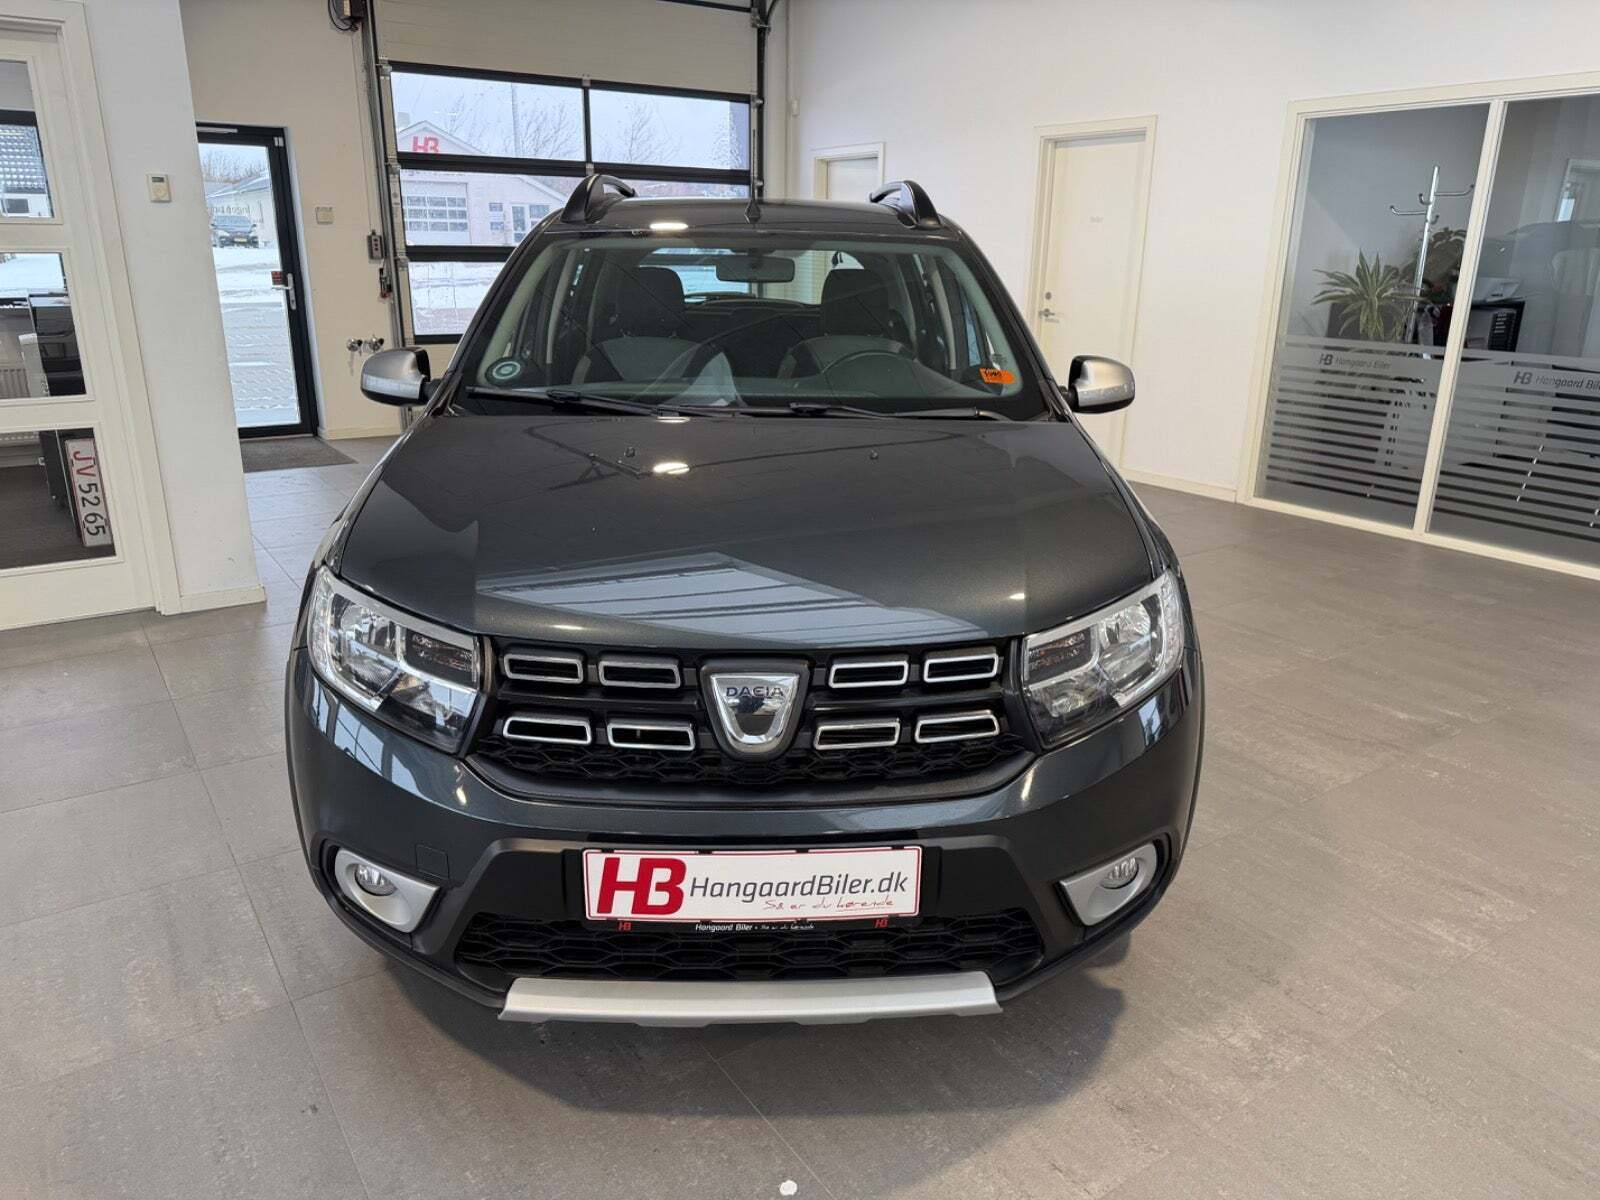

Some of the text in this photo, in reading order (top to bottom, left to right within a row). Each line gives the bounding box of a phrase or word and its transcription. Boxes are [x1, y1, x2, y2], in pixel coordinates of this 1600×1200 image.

[412, 135, 440, 152] HB
[1513, 371, 1533, 385] HB
[726, 686, 784, 698] DACIA
[596, 857, 908, 915] HB HangaardBiler.dk
[618, 921, 631, 931] HB
[874, 918, 888, 929] HB
